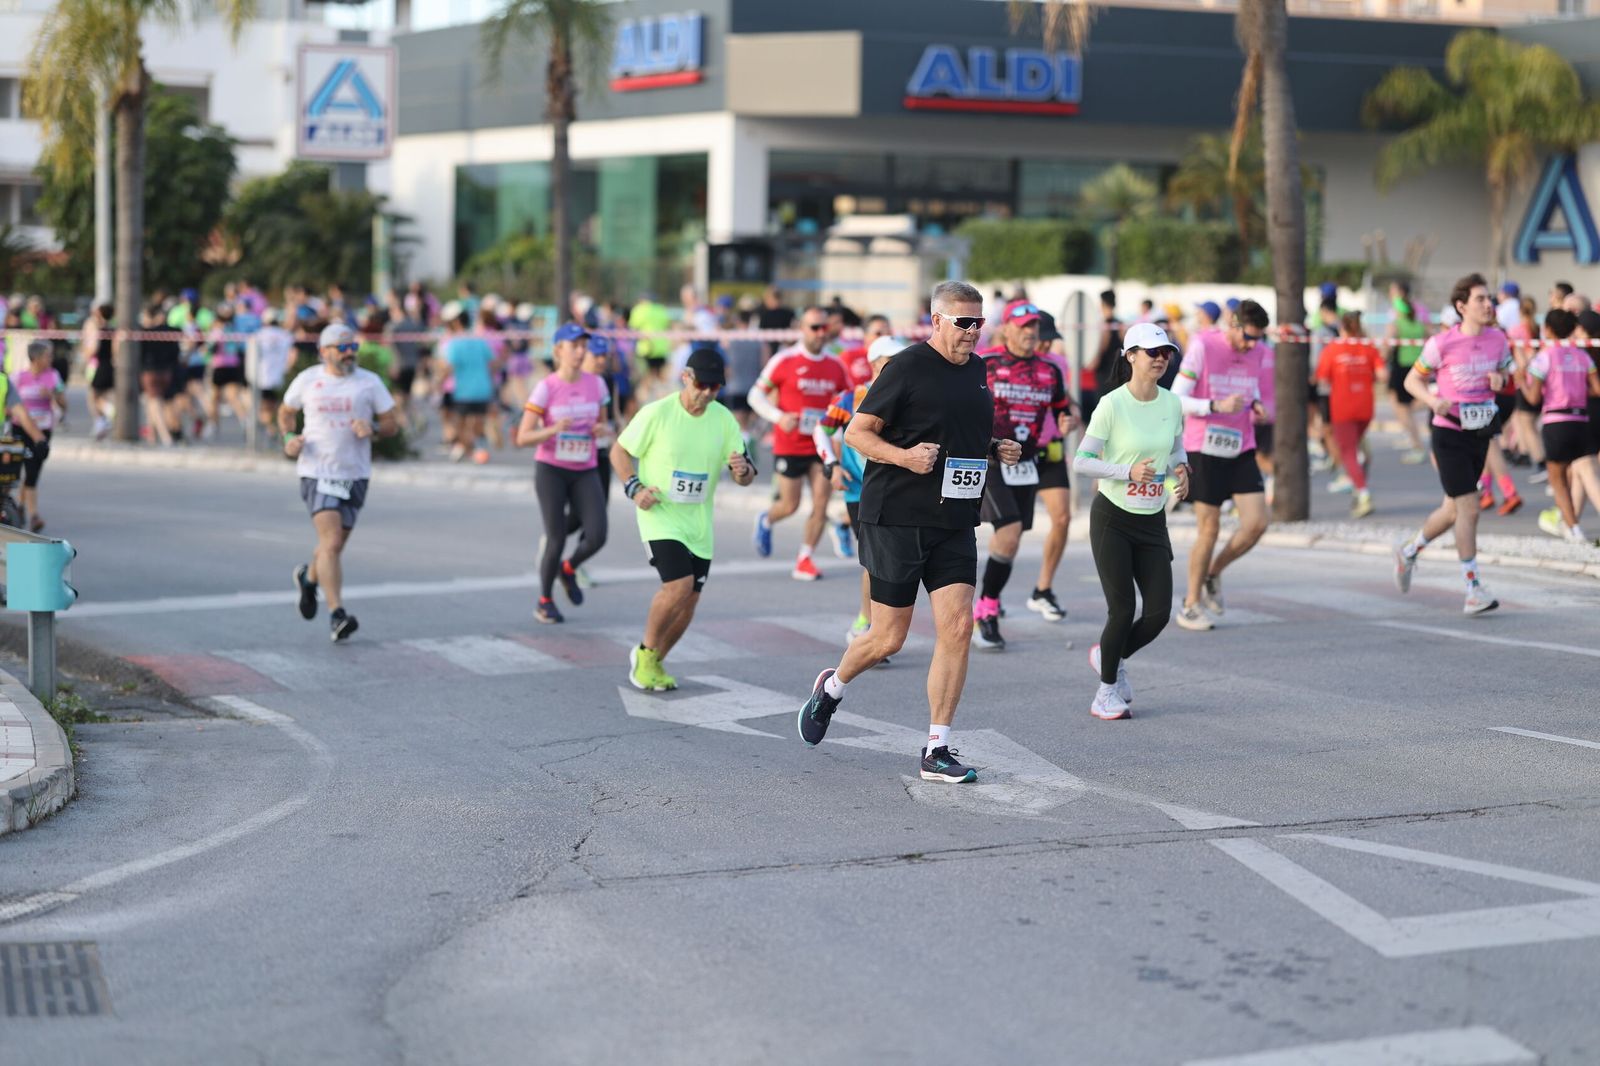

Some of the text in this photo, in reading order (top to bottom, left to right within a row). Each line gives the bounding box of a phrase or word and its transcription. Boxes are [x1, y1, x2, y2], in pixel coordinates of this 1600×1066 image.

[611, 12, 706, 75] ALDI
[906, 44, 1082, 103] ALDI
[951, 470, 982, 486] 553
[676, 480, 703, 493] 514
[1127, 482, 1164, 497] 2430
